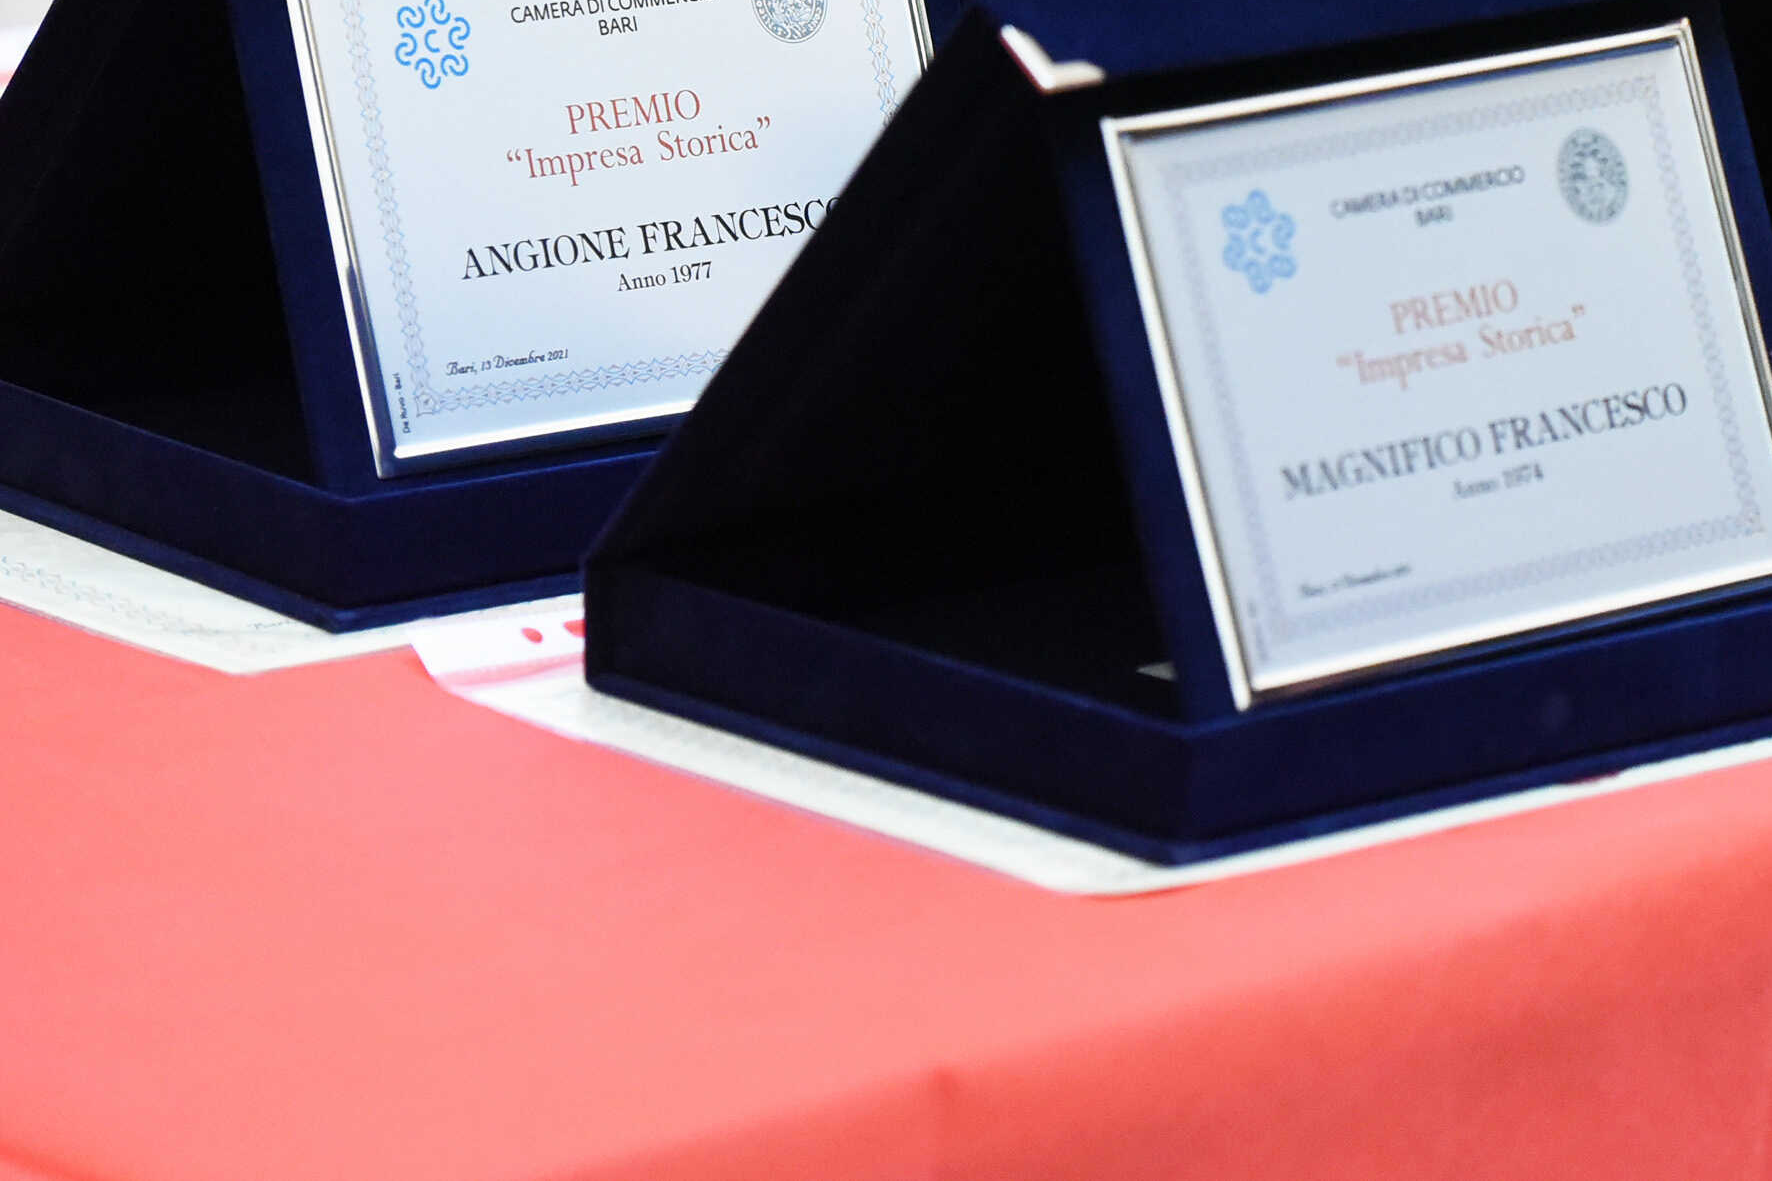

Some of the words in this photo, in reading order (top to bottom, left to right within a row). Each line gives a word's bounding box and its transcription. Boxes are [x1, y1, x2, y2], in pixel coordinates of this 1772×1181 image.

[511, 0, 585, 23] CAMERA
[598, 16, 638, 36] BARI
[565, 89, 701, 135] PREMIO
[506, 144, 644, 187] “Impresa
[656, 116, 771, 161] Storica”
[461, 226, 630, 280] ANGIONE
[616, 272, 667, 292] Anno
[671, 261, 713, 284] 1977
[1389, 279, 1519, 335] PREMIO
[446, 361, 478, 377] Bari,
[493, 350, 545, 369] Dicembre
[547, 349, 569, 362] 2021
[1336, 341, 1468, 390] “Impresa
[1477, 304, 1585, 358] Storica”
[1281, 426, 1482, 501] MAGNIFICO
[1488, 382, 1688, 455] FRANCESCO
